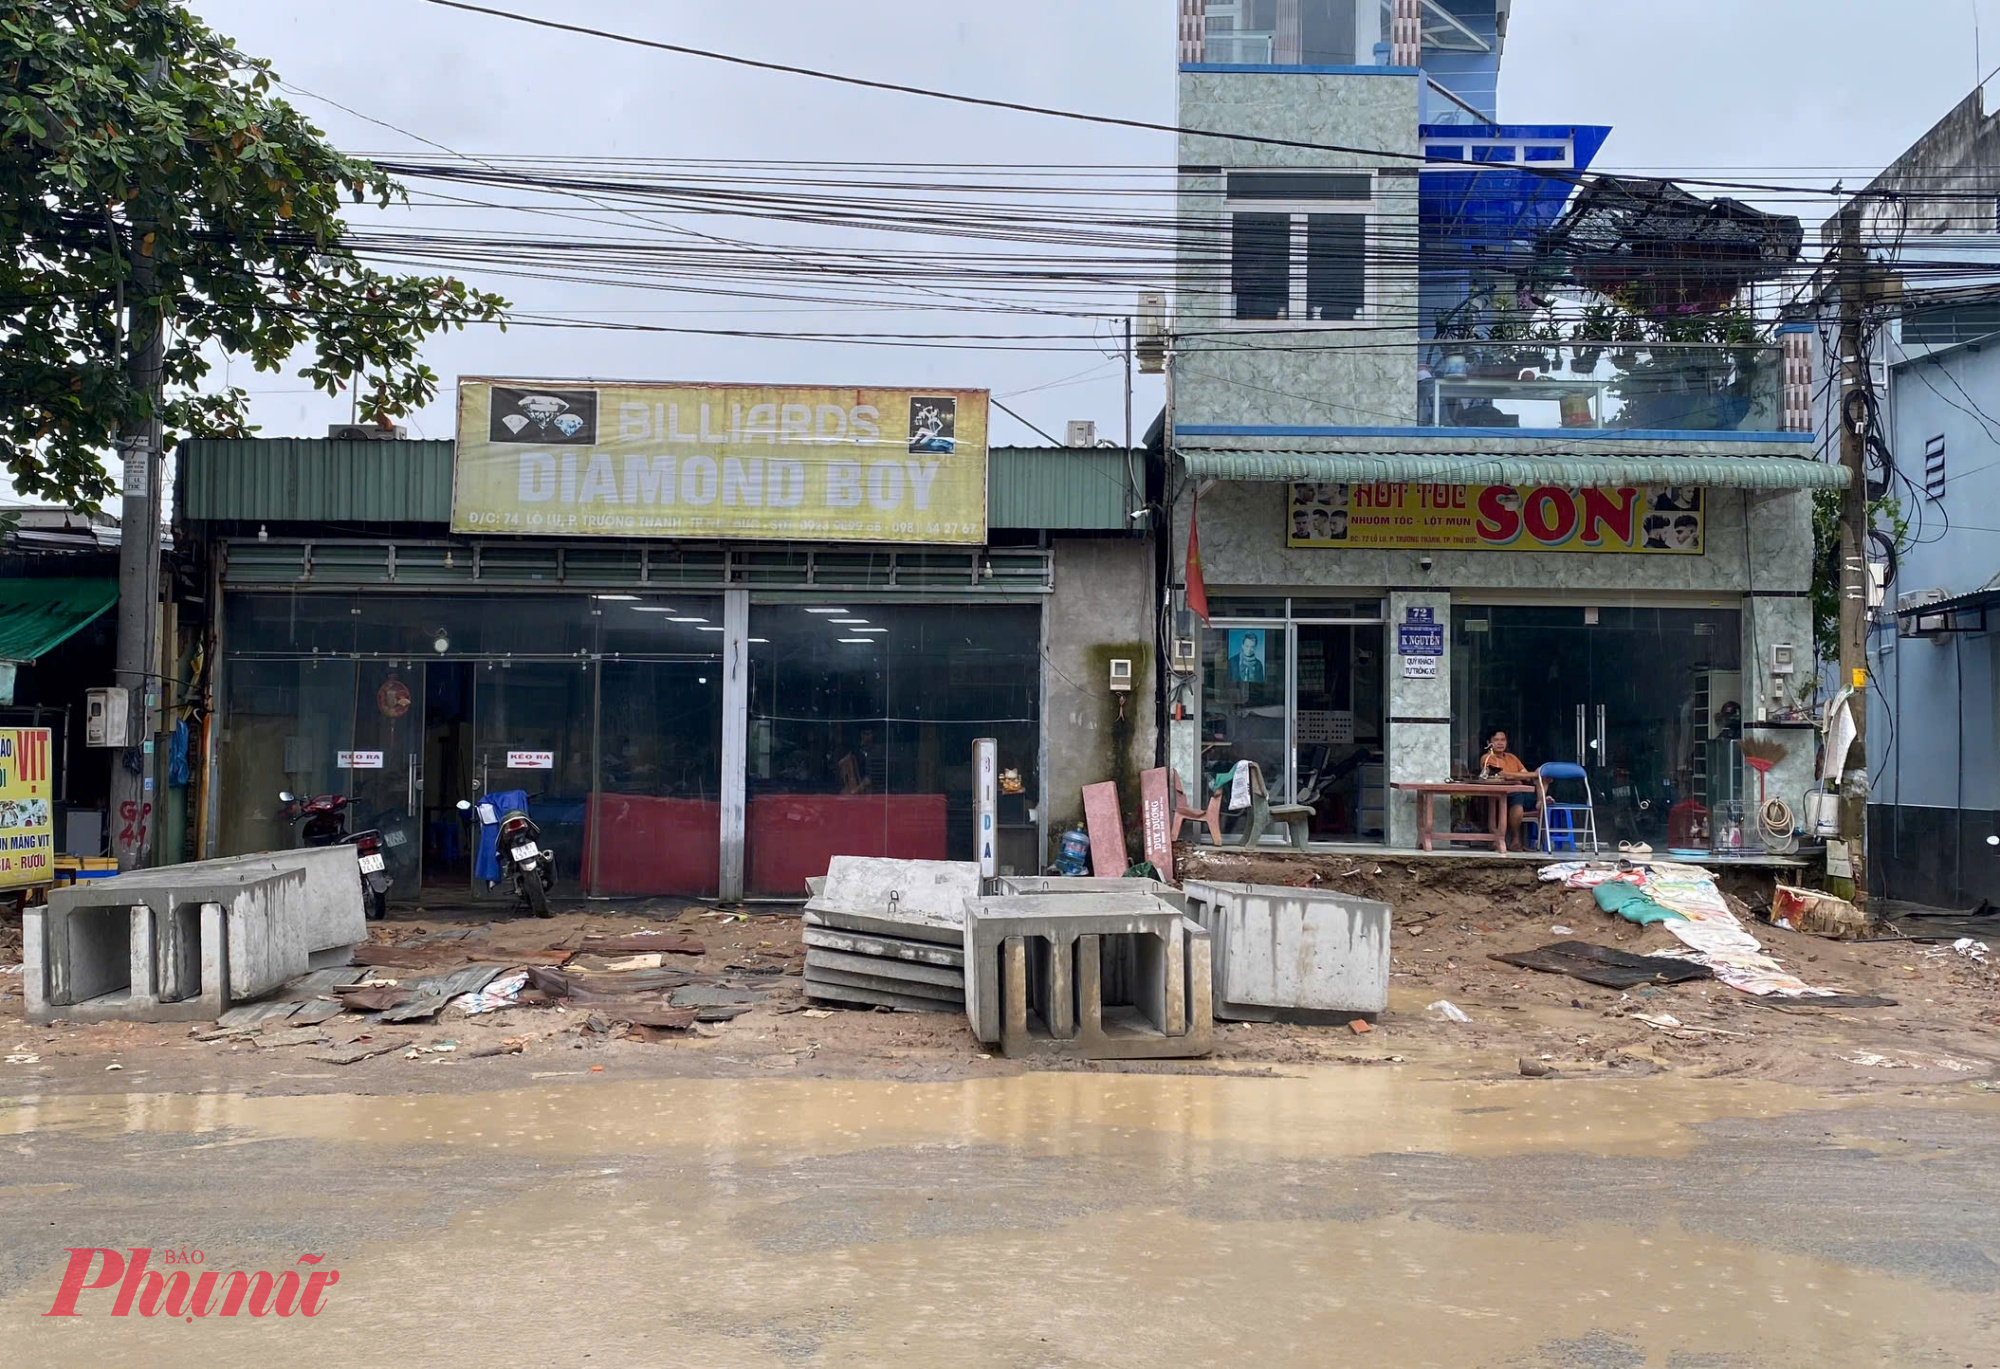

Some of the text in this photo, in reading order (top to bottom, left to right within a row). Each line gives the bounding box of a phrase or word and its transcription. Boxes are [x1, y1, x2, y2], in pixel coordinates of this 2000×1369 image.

[619, 401, 880, 445] BILLIARDS
[518, 451, 940, 510] DIAMOND BOY
[1413, 608, 1427, 618] 72
[1402, 635, 1408, 645] K
[17, 730, 48, 793] VỊT
[1151, 801, 1162, 850] DUY DƯƠNG
[38, 834, 49, 850] VỊT
[0, 858, 11, 871] IA
[21, 854, 46, 870] RƯỢU
